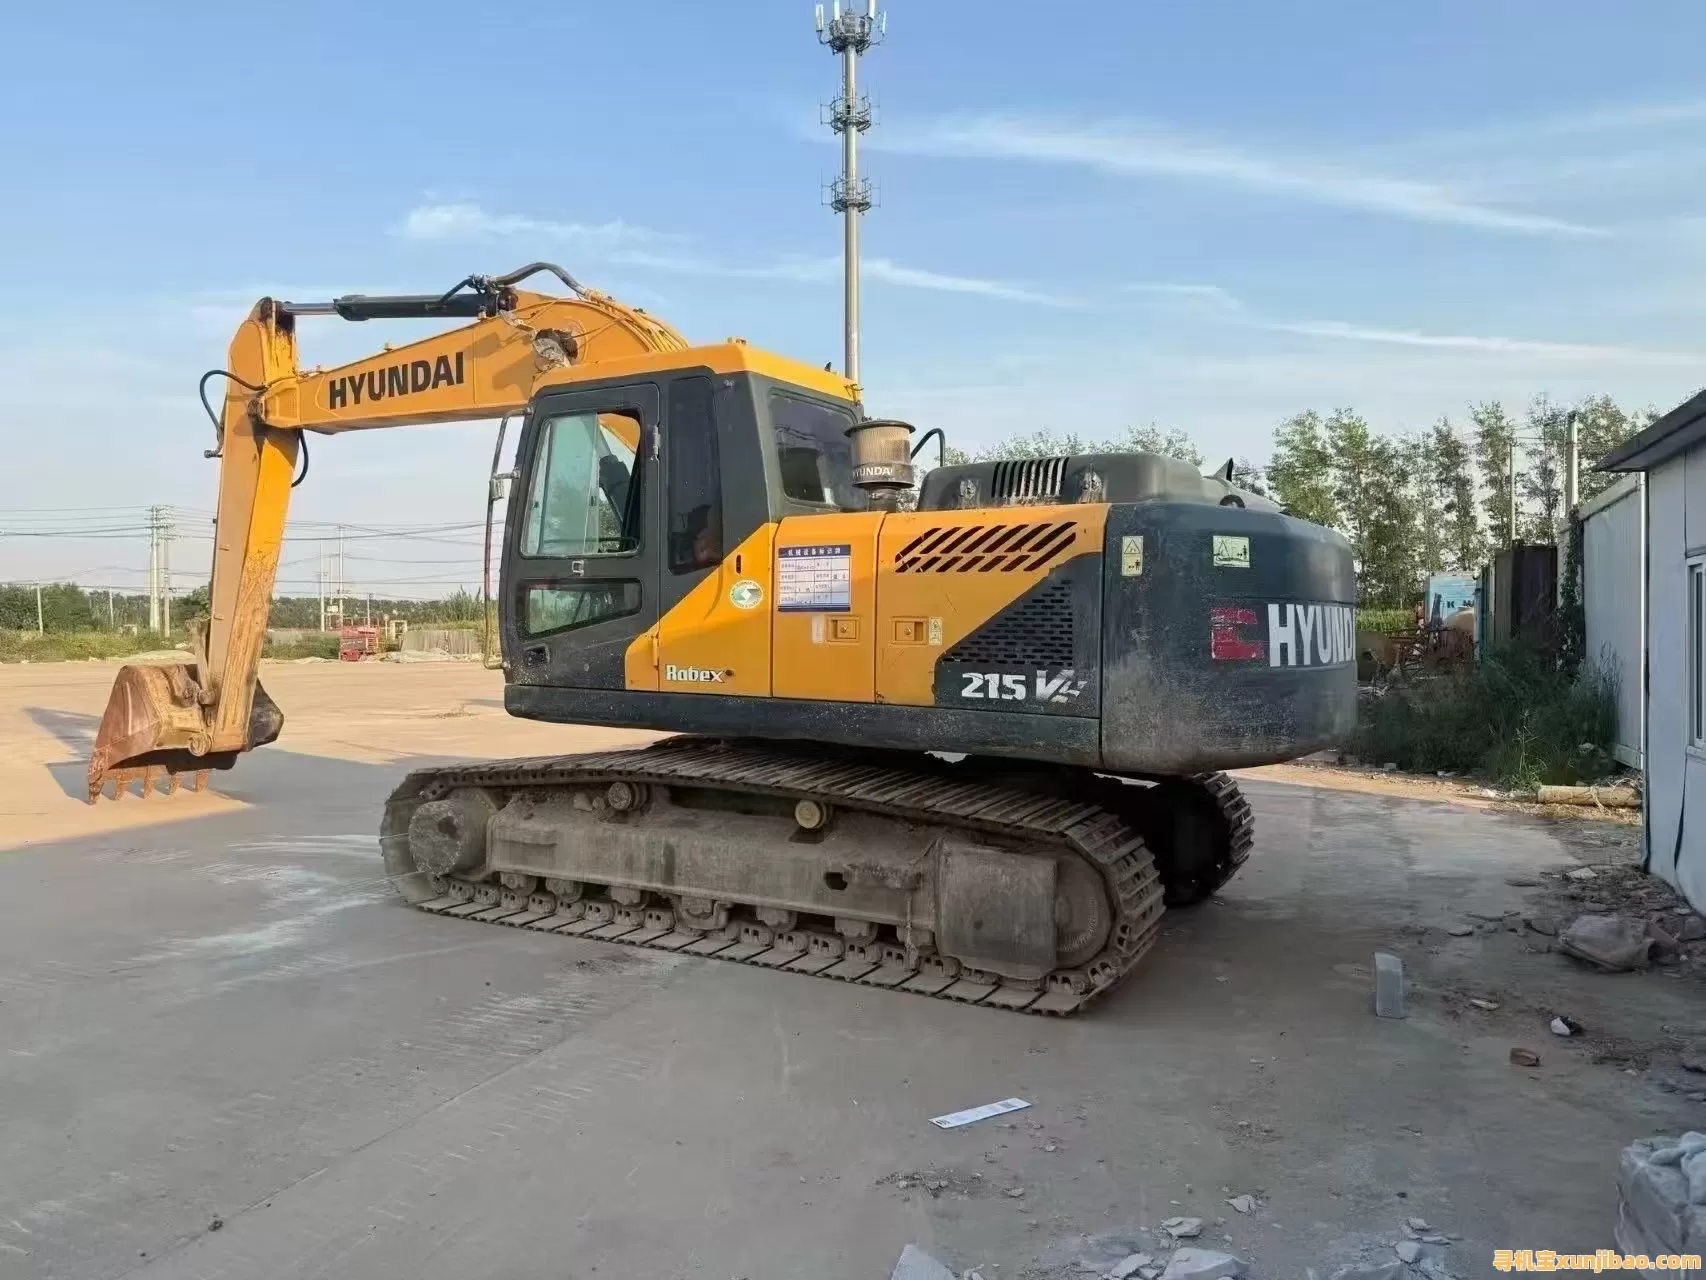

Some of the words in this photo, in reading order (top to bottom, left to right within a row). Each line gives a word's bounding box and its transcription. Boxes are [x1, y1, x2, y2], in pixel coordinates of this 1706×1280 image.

[329, 351, 464, 410] HYUNDAI
[1267, 603, 1356, 668] HYUND
[961, 672, 1026, 700] 215
